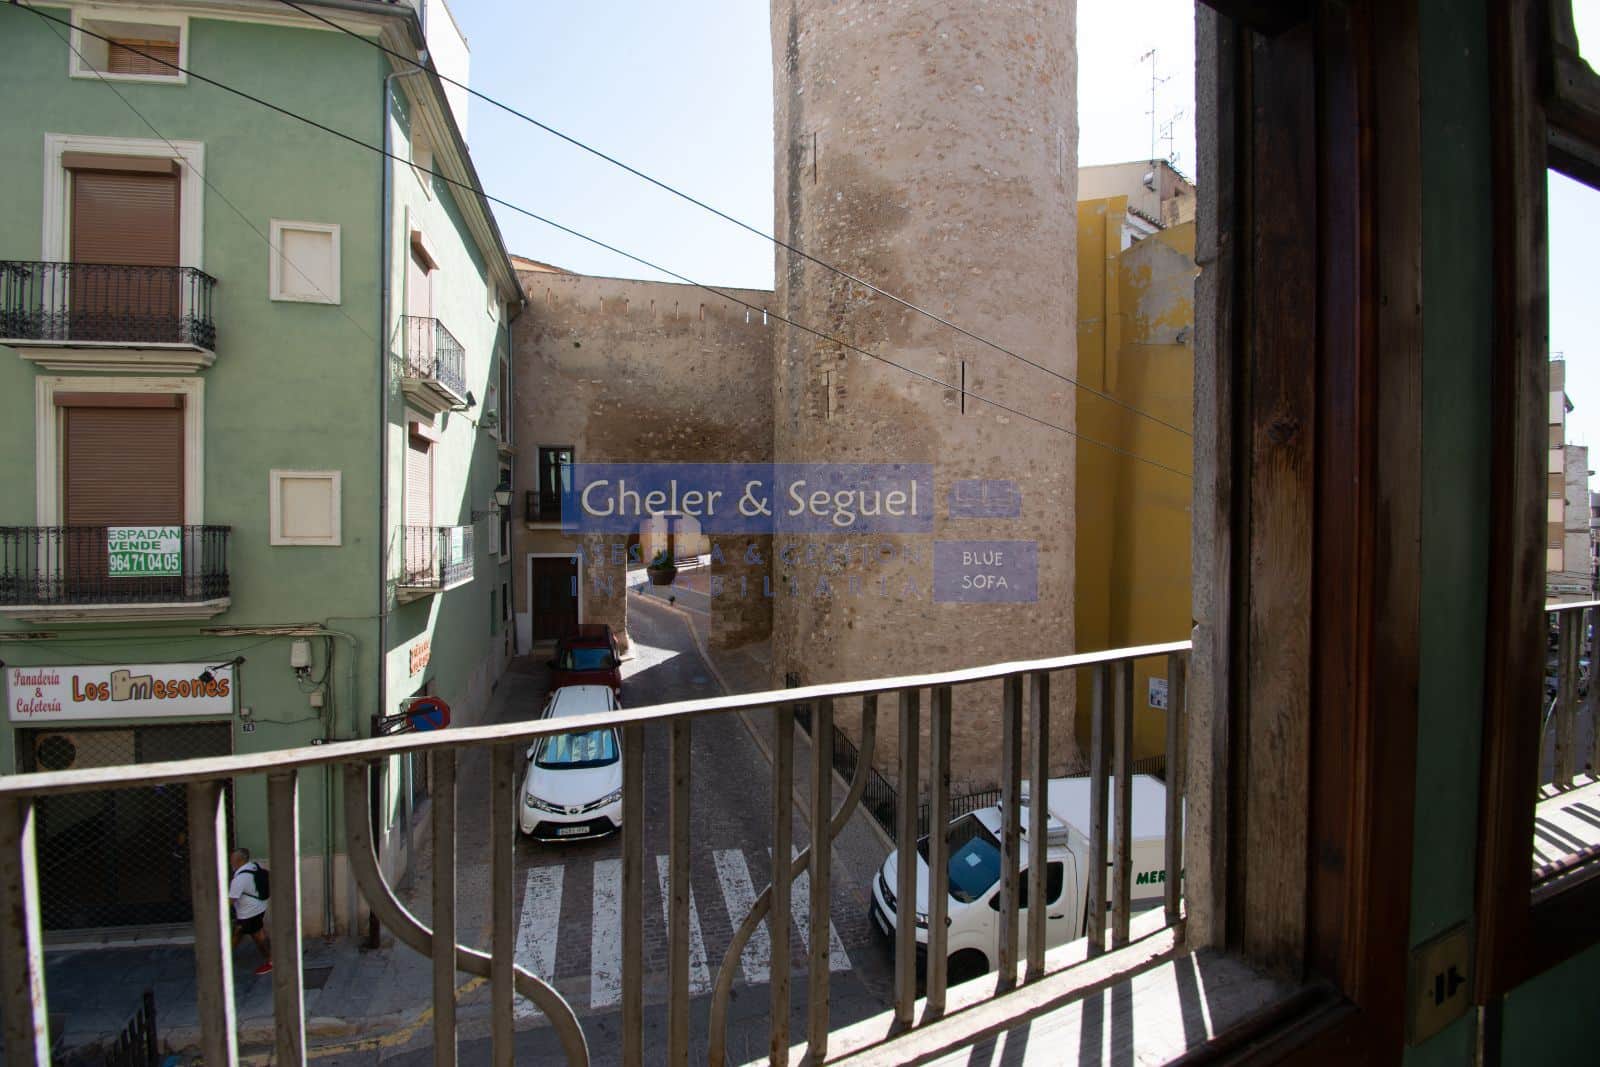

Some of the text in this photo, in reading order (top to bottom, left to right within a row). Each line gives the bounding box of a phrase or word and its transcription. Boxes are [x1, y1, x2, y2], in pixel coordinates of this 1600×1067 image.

[108, 527, 180, 540] ESPADÁN
[108, 541, 161, 551] VENDE
[110, 553, 179, 571] 964 71 04 05
[14, 668, 60, 686] Panadería
[35, 687, 43, 698] &
[72, 675, 110, 702] Los
[16, 697, 62, 717] Cafetería
